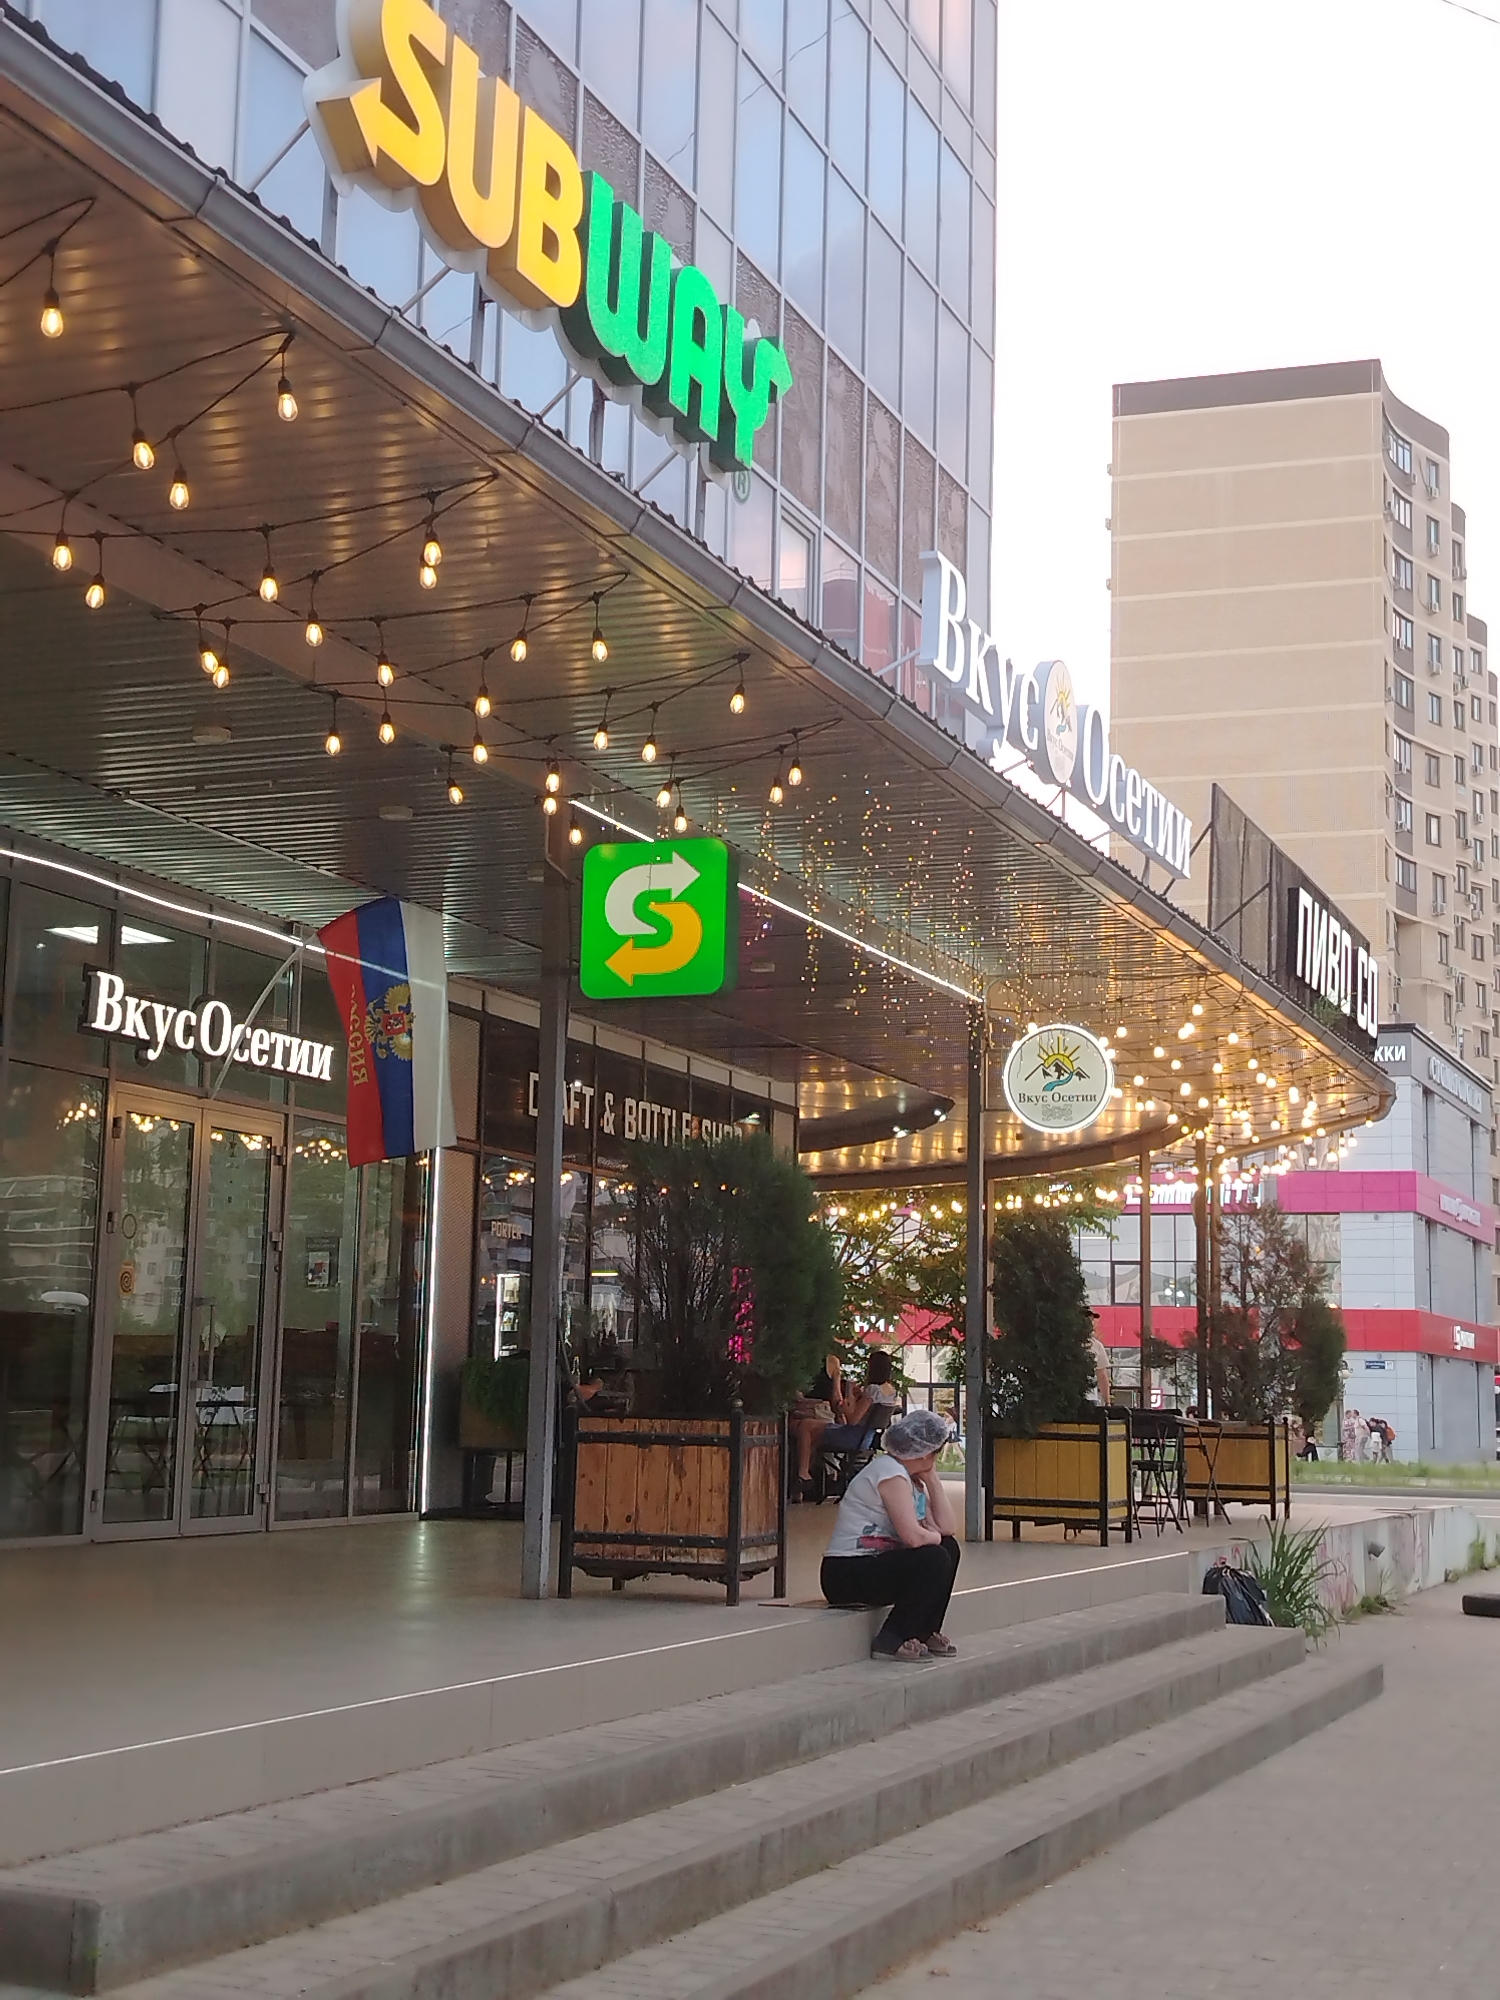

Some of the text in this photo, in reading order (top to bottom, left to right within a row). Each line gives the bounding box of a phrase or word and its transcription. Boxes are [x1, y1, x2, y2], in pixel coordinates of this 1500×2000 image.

[320, 0, 793, 469] SUBWAY
[932, 550, 1192, 879] Вкус Осетии
[1297, 887, 1351, 1016] ПИВО
[528, 1071, 594, 1130] DAFT
[603, 1091, 616, 1136] &
[1018, 1091, 1097, 1106] Вкус Осетии
